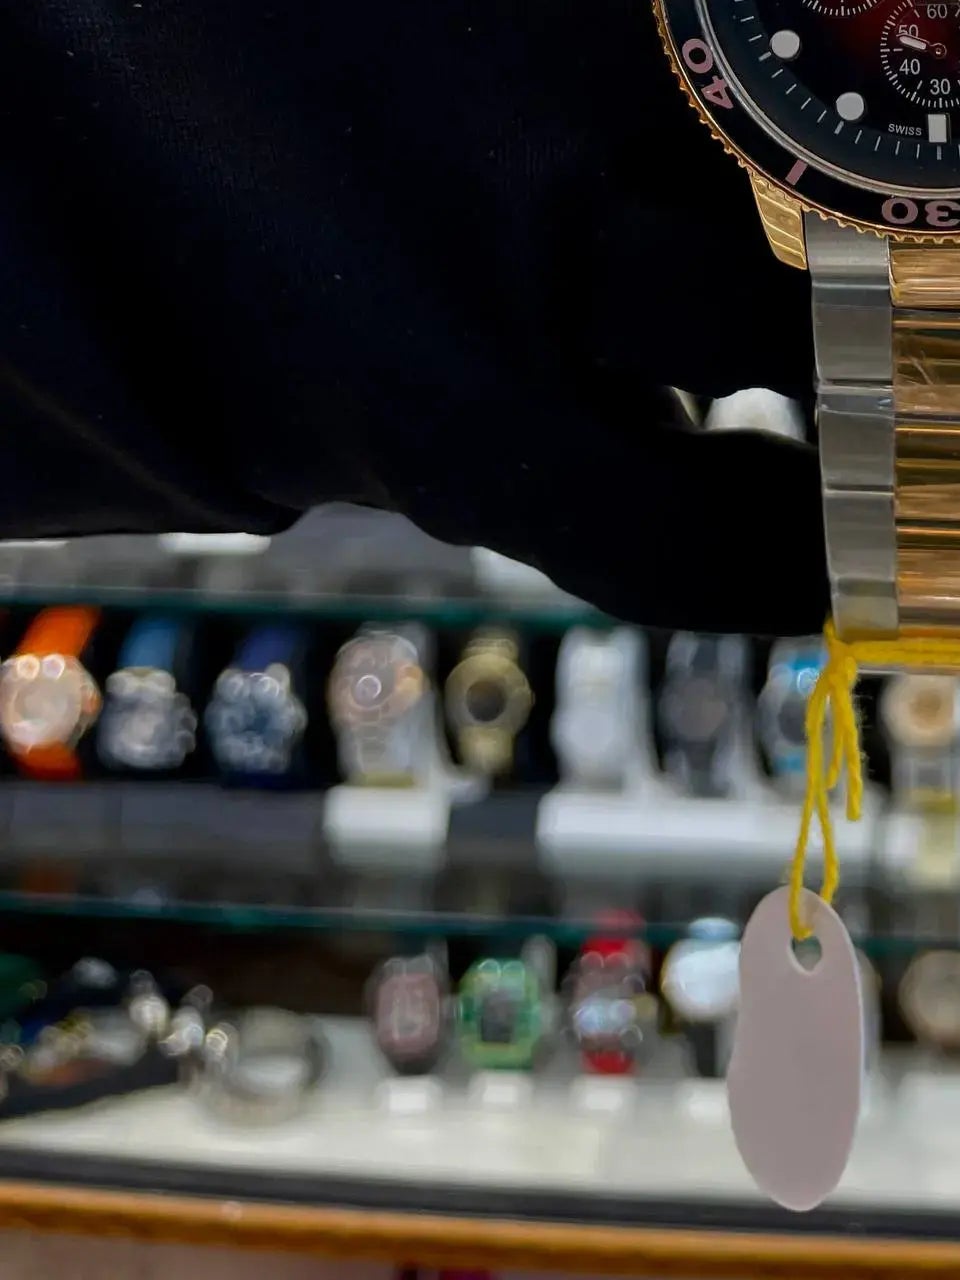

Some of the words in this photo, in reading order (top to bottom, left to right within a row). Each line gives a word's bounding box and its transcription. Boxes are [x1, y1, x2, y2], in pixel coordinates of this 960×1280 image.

[926, 3, 948, 19] 60
[681, 37, 734, 110] 40
[900, 58, 921, 75] 40
[929, 78, 951, 95] 30
[888, 123, 922, 137] SWISS
